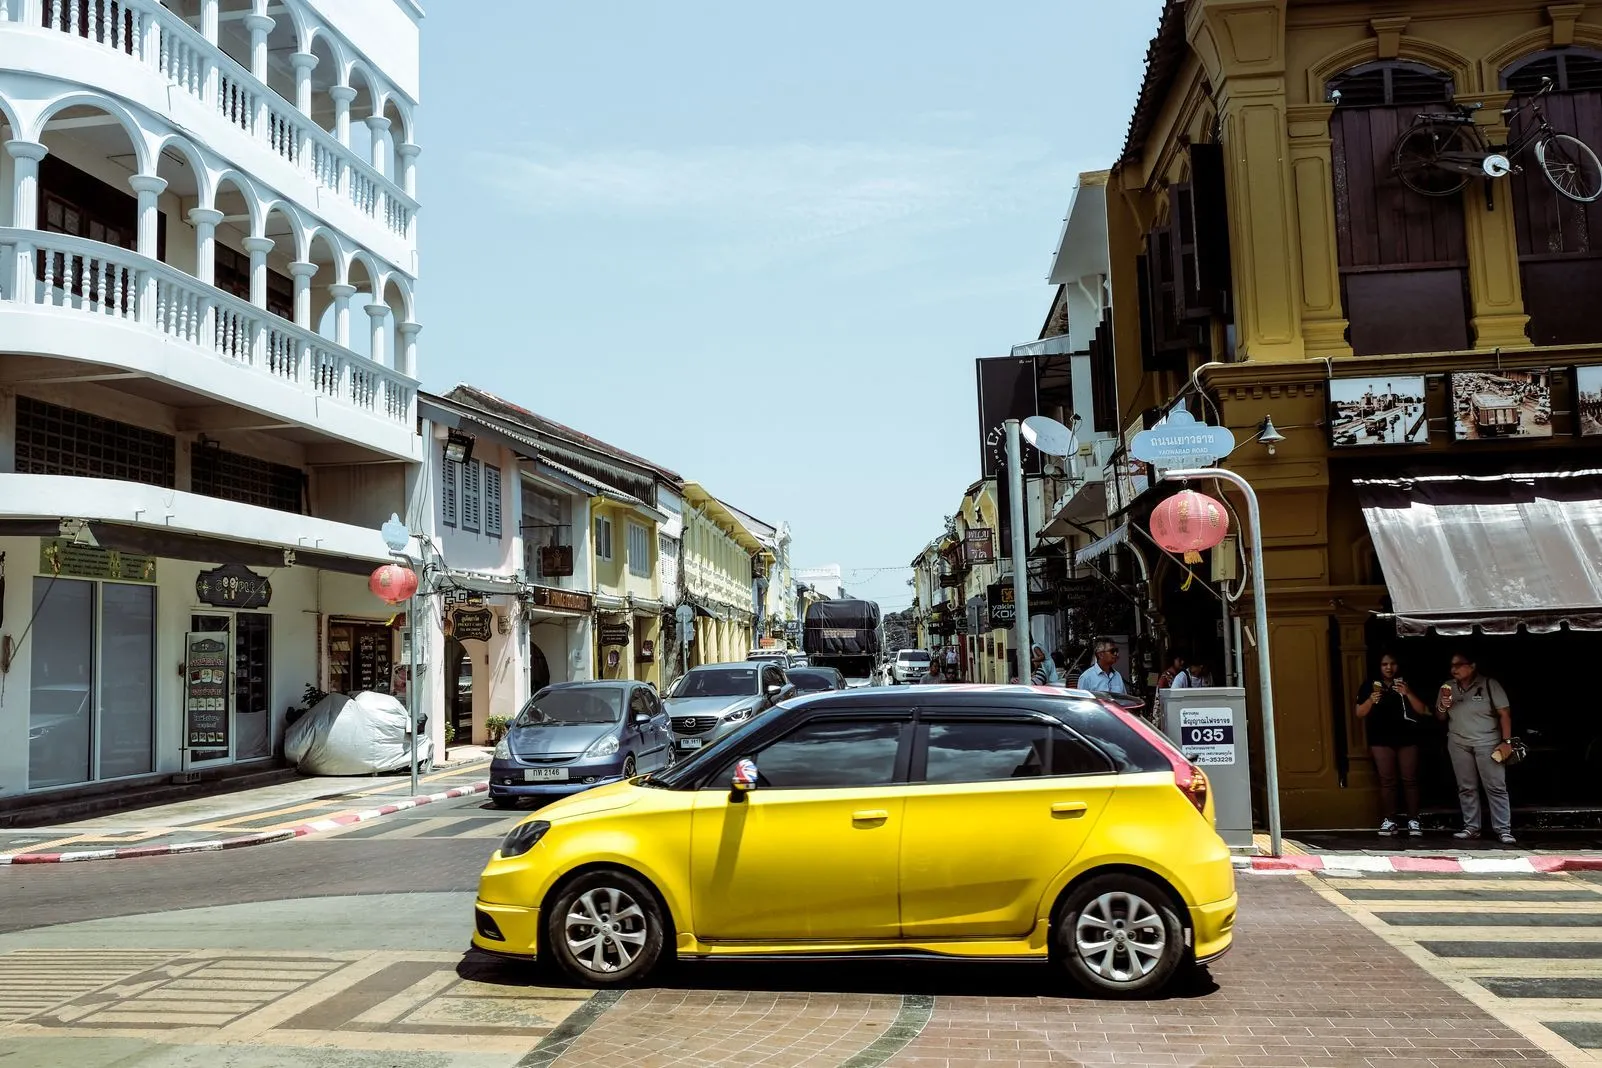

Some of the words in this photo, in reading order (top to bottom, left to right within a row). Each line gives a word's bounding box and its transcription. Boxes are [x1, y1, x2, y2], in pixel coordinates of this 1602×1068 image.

[1150, 435, 1214, 446] ถนนเยาวราช
[1191, 729, 1224, 742] 035
